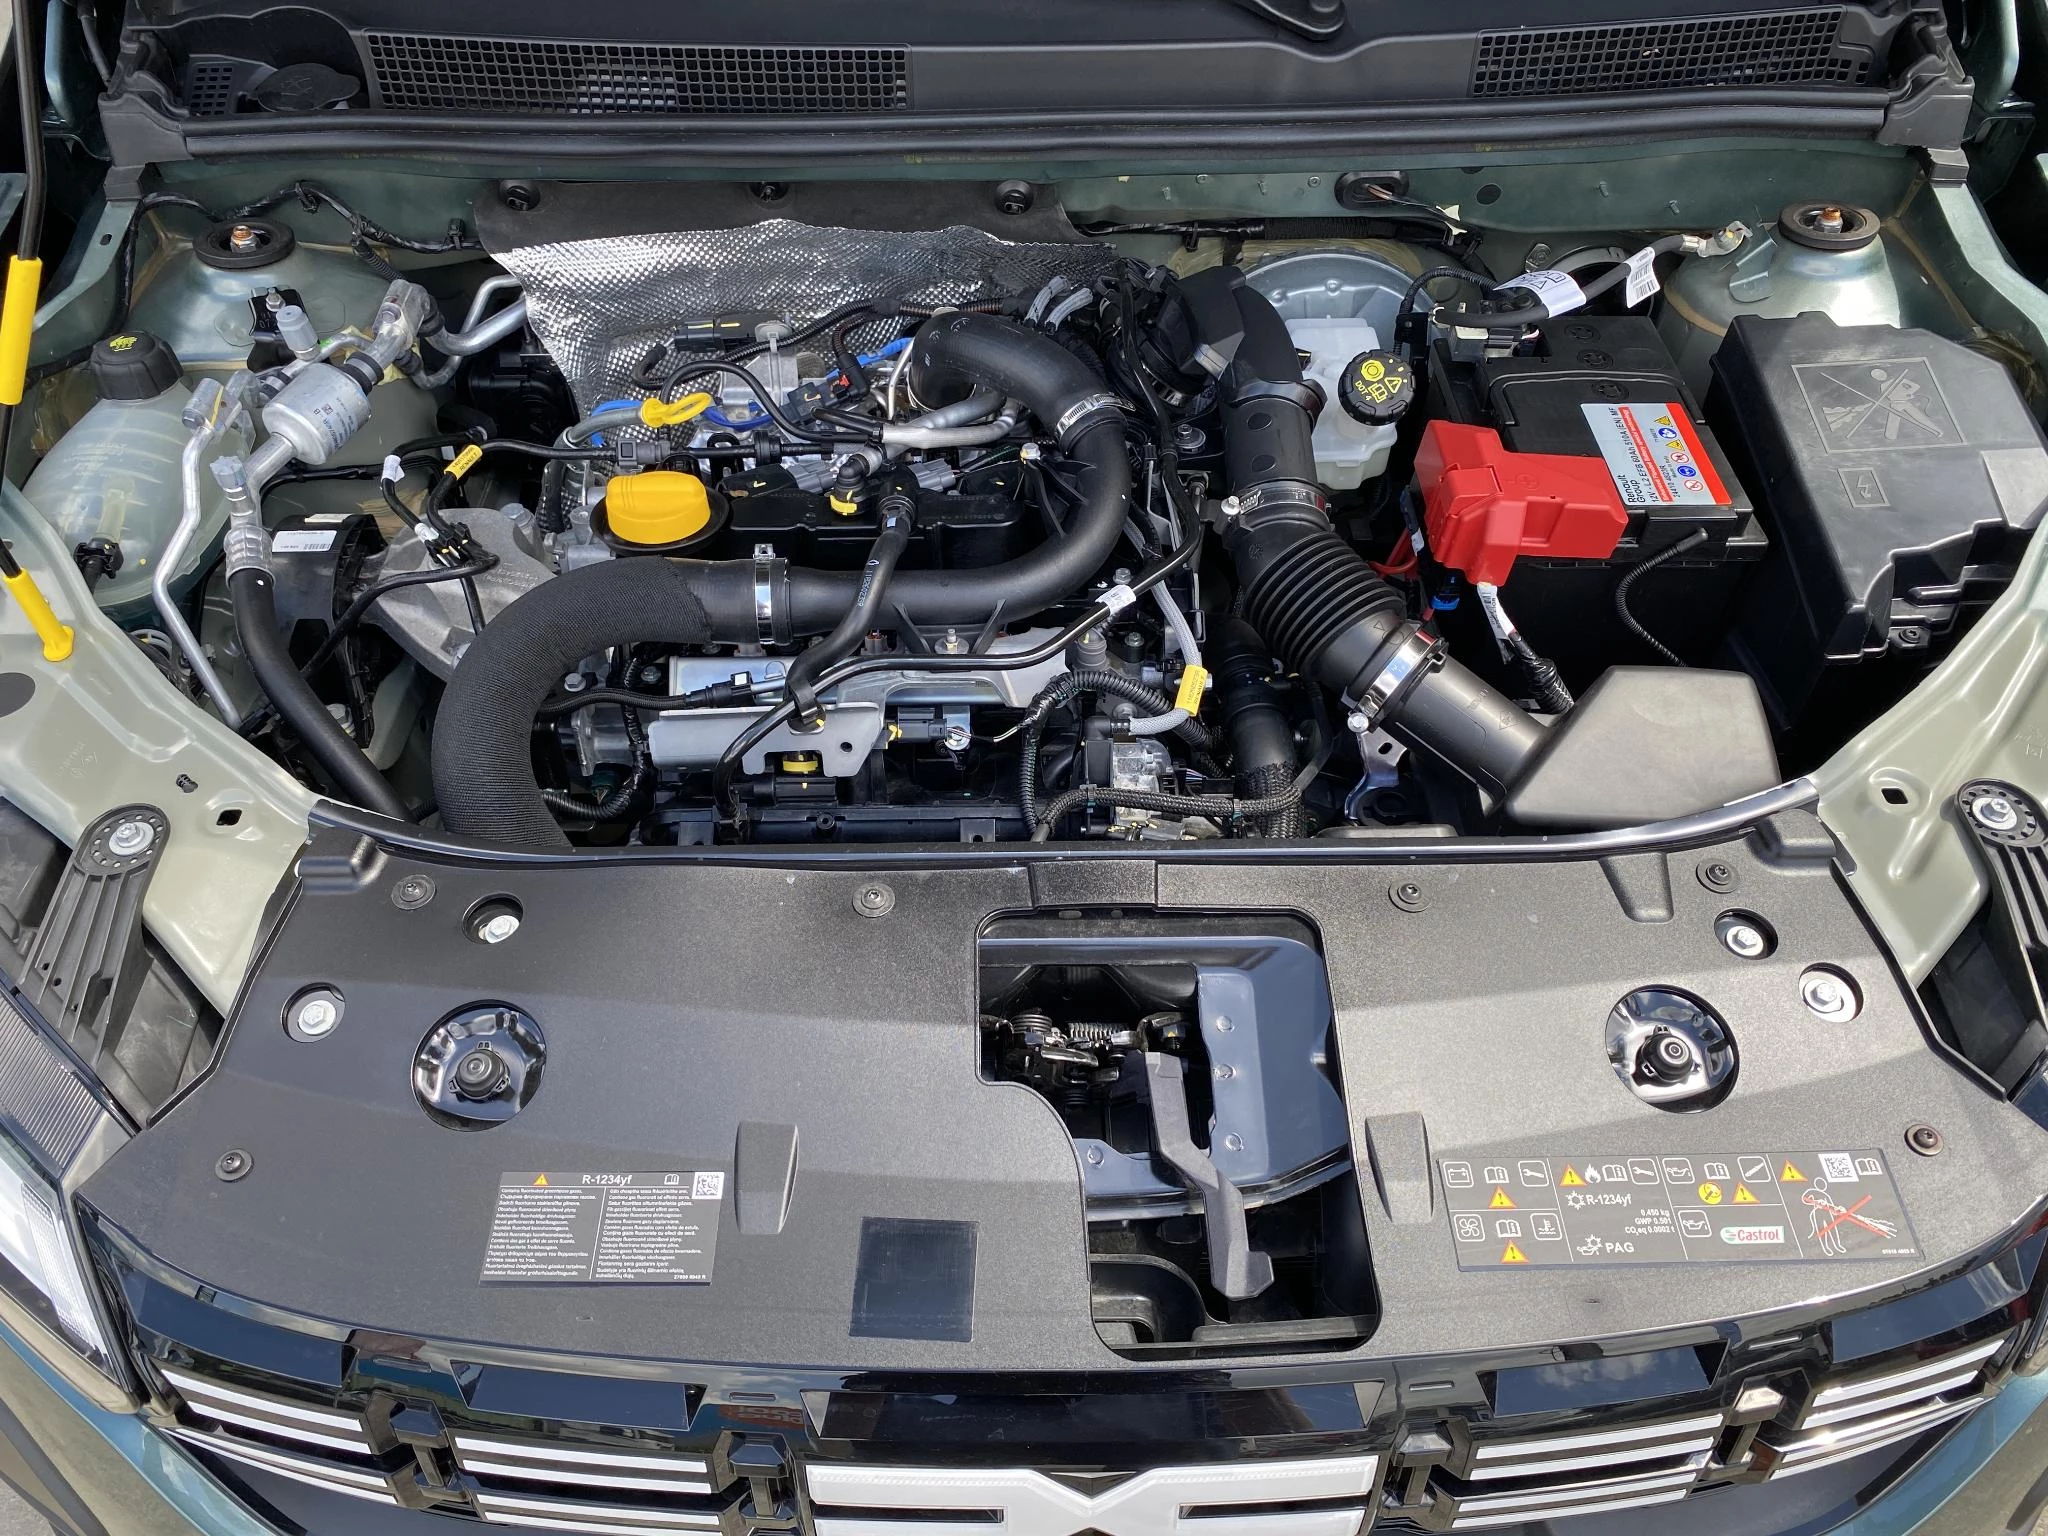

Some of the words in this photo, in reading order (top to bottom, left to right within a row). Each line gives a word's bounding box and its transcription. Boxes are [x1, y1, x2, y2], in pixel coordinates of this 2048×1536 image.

[1355, 380, 1369, 394] DOT
[1634, 464, 1648, 475] EFB
[1616, 474, 1637, 502] Renault
[1628, 479, 1648, 502] Group
[1647, 491, 1660, 502] 12V
[582, 1175, 632, 1186] R-1234yf
[1586, 1193, 1632, 1207] R-1234yf
[1634, 1217, 1652, 1225] GWP
[1737, 1229, 1781, 1241] Castrol
[1605, 1242, 1634, 1253] PAG
